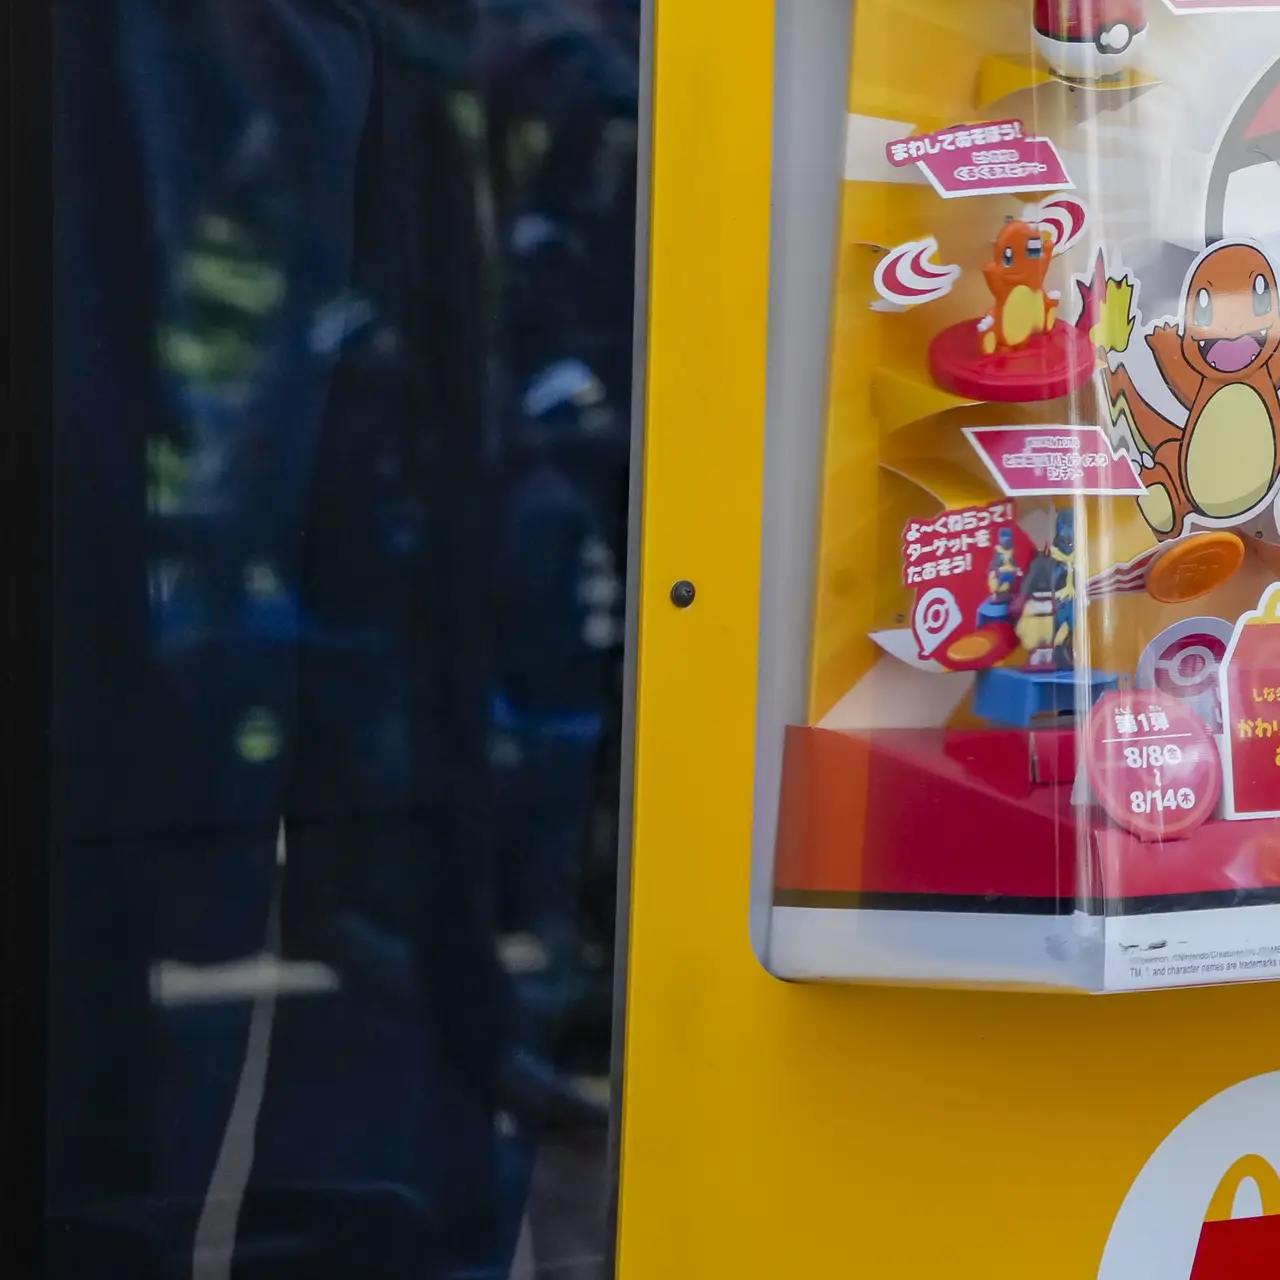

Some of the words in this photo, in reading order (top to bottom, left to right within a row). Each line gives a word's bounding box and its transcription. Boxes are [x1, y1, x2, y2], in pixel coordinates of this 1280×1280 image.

[891, 122, 1023, 161] まわしてあそぼう!
[907, 530, 991, 562] ターゲットを
[907, 553, 972, 583] たおそう!
[1115, 712, 1170, 734] 第1弾
[1152, 965, 1166, 976] and
[1167, 962, 1200, 976] character
[1201, 961, 1224, 973] names
[1226, 960, 1237, 971] are
[1239, 957, 1278, 970] trademarks
